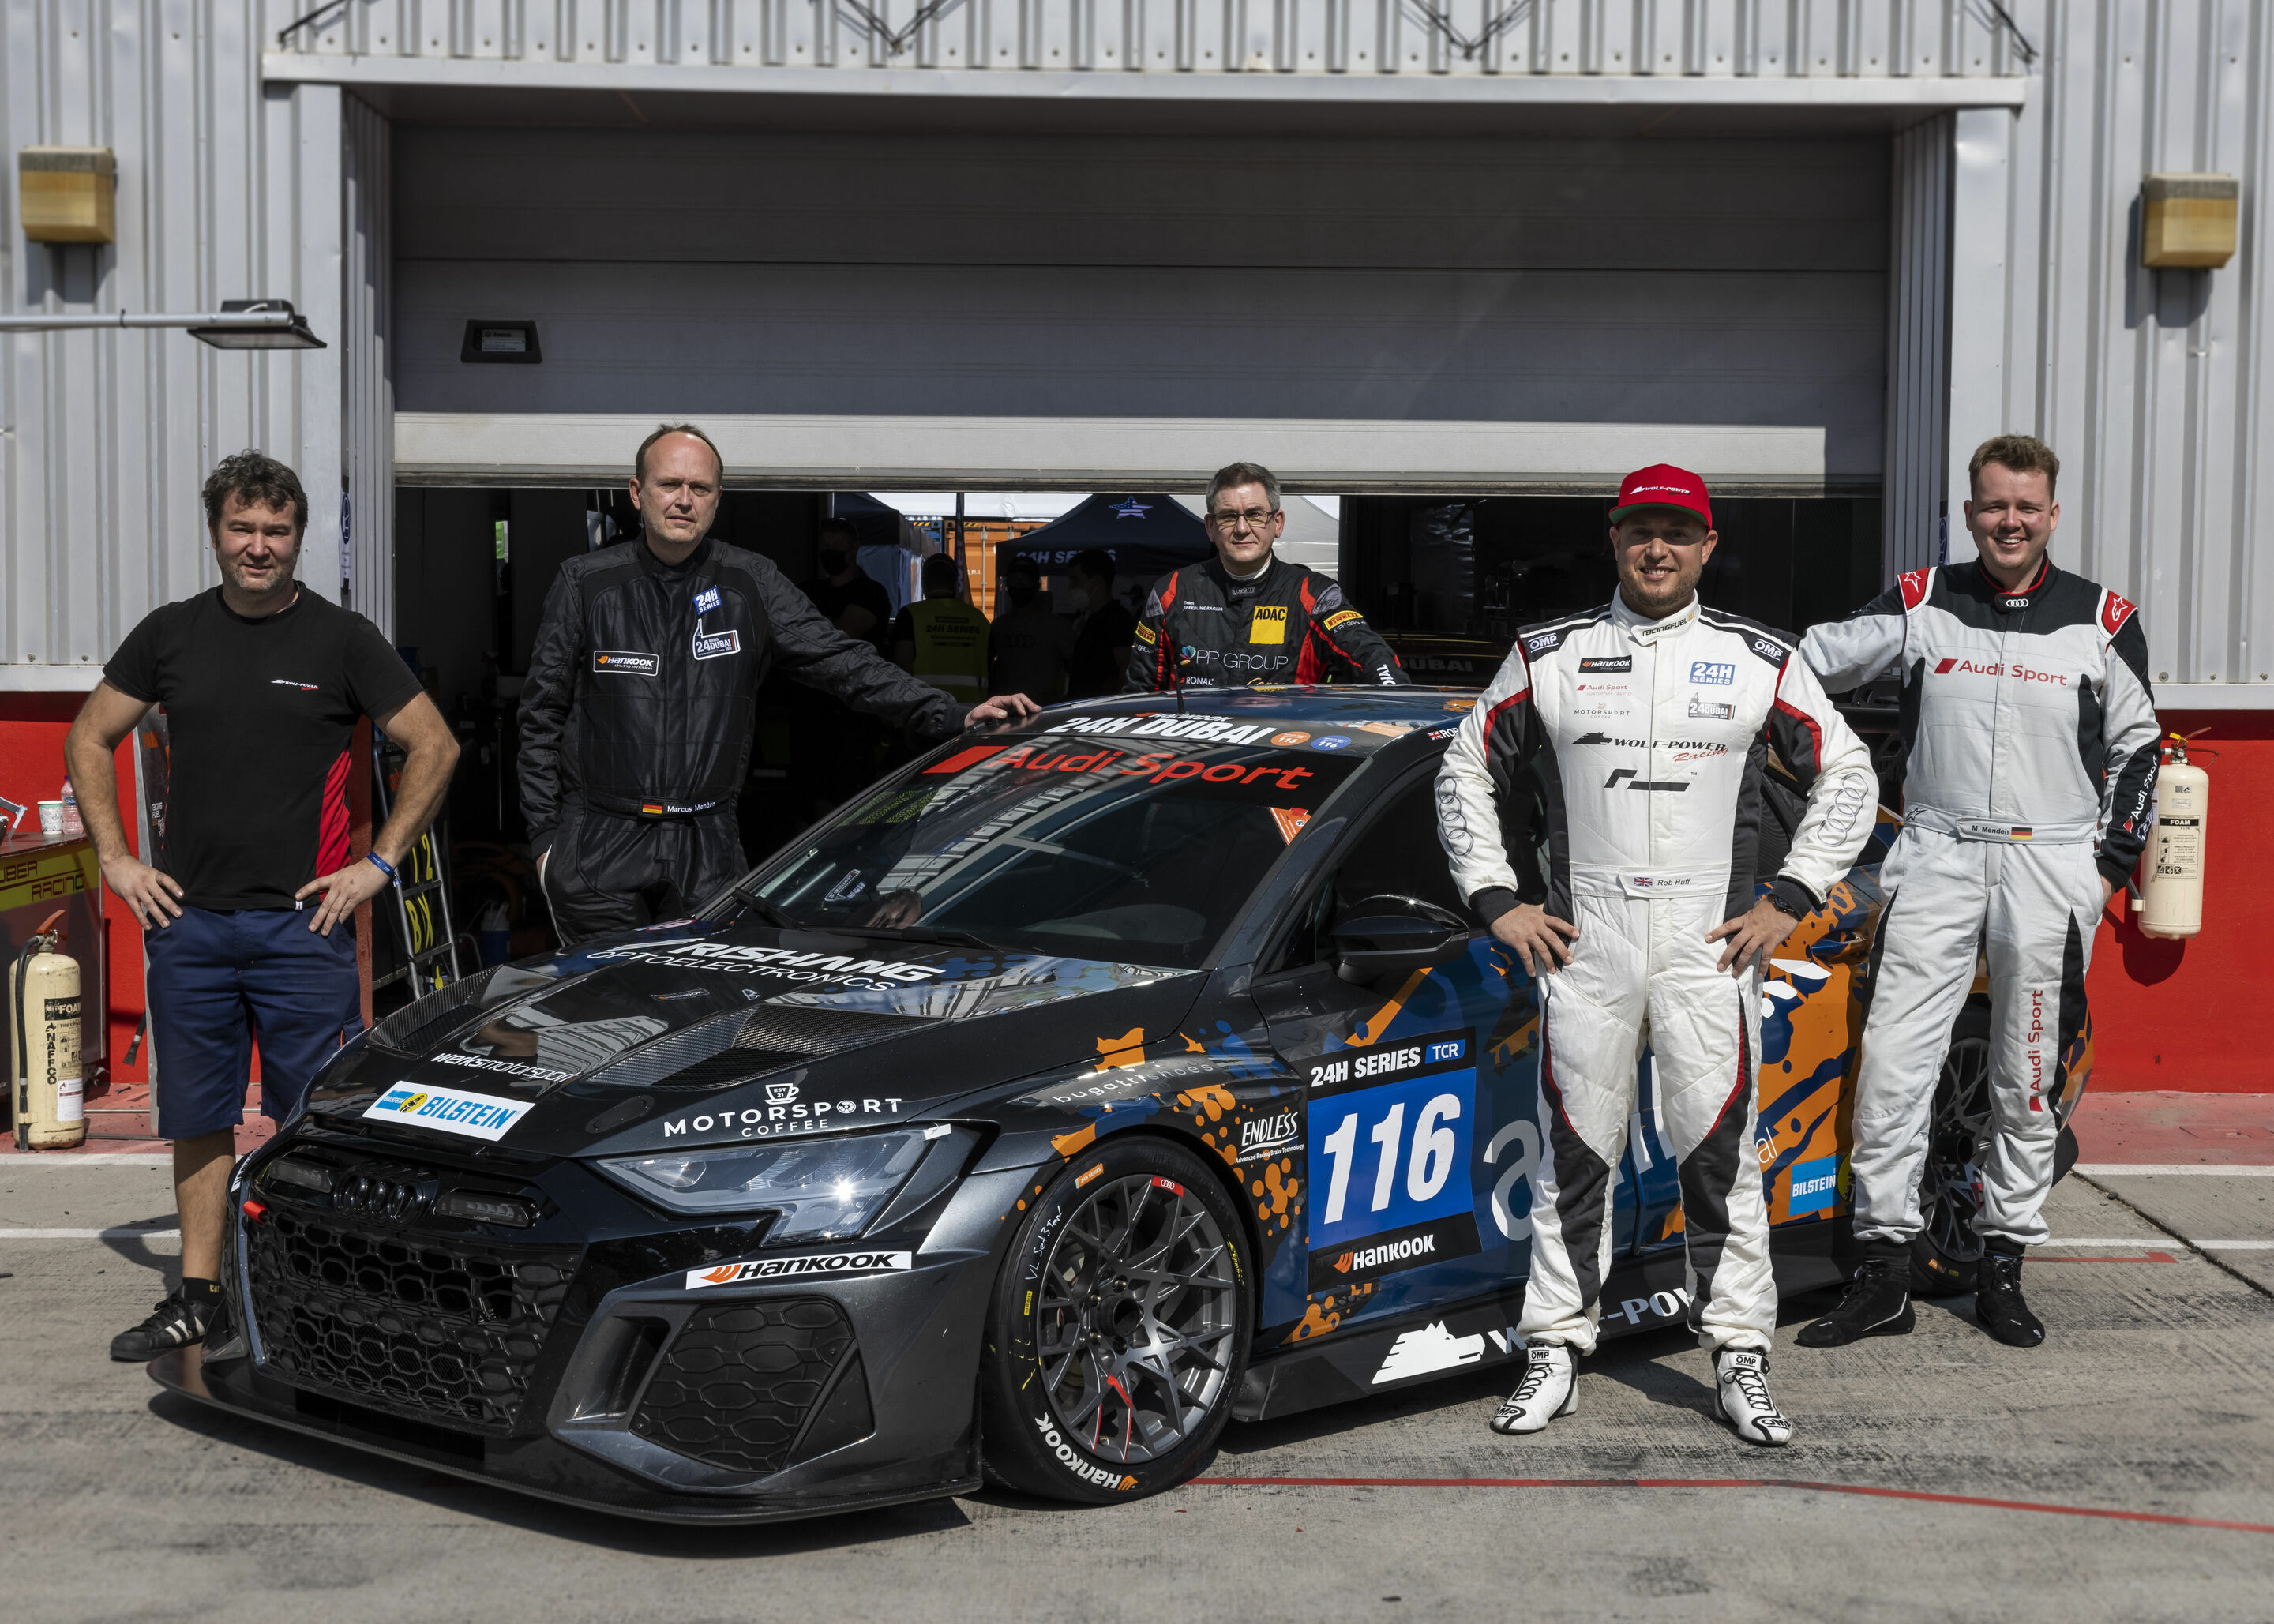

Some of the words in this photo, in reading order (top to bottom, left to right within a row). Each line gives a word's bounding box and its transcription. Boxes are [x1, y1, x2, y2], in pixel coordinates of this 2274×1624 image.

[696, 588, 719, 607] 24H
[699, 601, 720, 613] SERIES
[1255, 608, 1286, 621] ADAC
[696, 639, 711, 653] 24
[710, 639, 731, 650] DUBAI
[1529, 635, 1557, 650] OMP
[1754, 641, 1782, 658] OMP
[1196, 650, 1220, 665] PP
[1224, 653, 1289, 670] GROUP
[1186, 677, 1213, 685] RONAL
[1693, 663, 1732, 679] 24H
[1958, 660, 2004, 677] Audi
[2011, 665, 2067, 685] Sport
[1690, 703, 1705, 714] 24
[1044, 717, 1139, 733] 24H
[1129, 717, 1278, 745] DUBAI
[1615, 738, 1726, 752] WOLF-POWER
[1672, 748, 1729, 764] Racing
[989, 746, 1125, 774] Audi
[1120, 752, 1314, 789] Sport
[2131, 790, 2148, 820] Audi
[1982, 827, 2009, 835] Menden
[32, 873, 84, 902] RACING
[587, 950, 896, 992] OPTOELECTRONICS
[669, 943, 947, 981] RISHANG
[2028, 989, 2044, 1044] Sport
[46, 1033, 57, 1086] NAFFCO
[431, 1052, 579, 1082] werksmotorsport
[1311, 1060, 1349, 1088] 24H
[1354, 1046, 1421, 1078] SERIES
[1432, 1042, 1458, 1060] TCR
[2028, 1049, 2042, 1092] Audi
[417, 1095, 516, 1130] BILSTEIN
[663, 1098, 902, 1137] MOTORSPORT
[741, 1119, 829, 1137] COFFEE
[1241, 1112, 1298, 1146] ENDLESS
[1236, 1153, 1256, 1164] Advanced
[1282, 1144, 1304, 1153] Technology
[1323, 1093, 1461, 1225] 116
[1792, 1174, 1836, 1198] BILSTEIN
[1531, 1351, 1550, 1360] OMP
[1736, 1356, 1756, 1365] OMP
